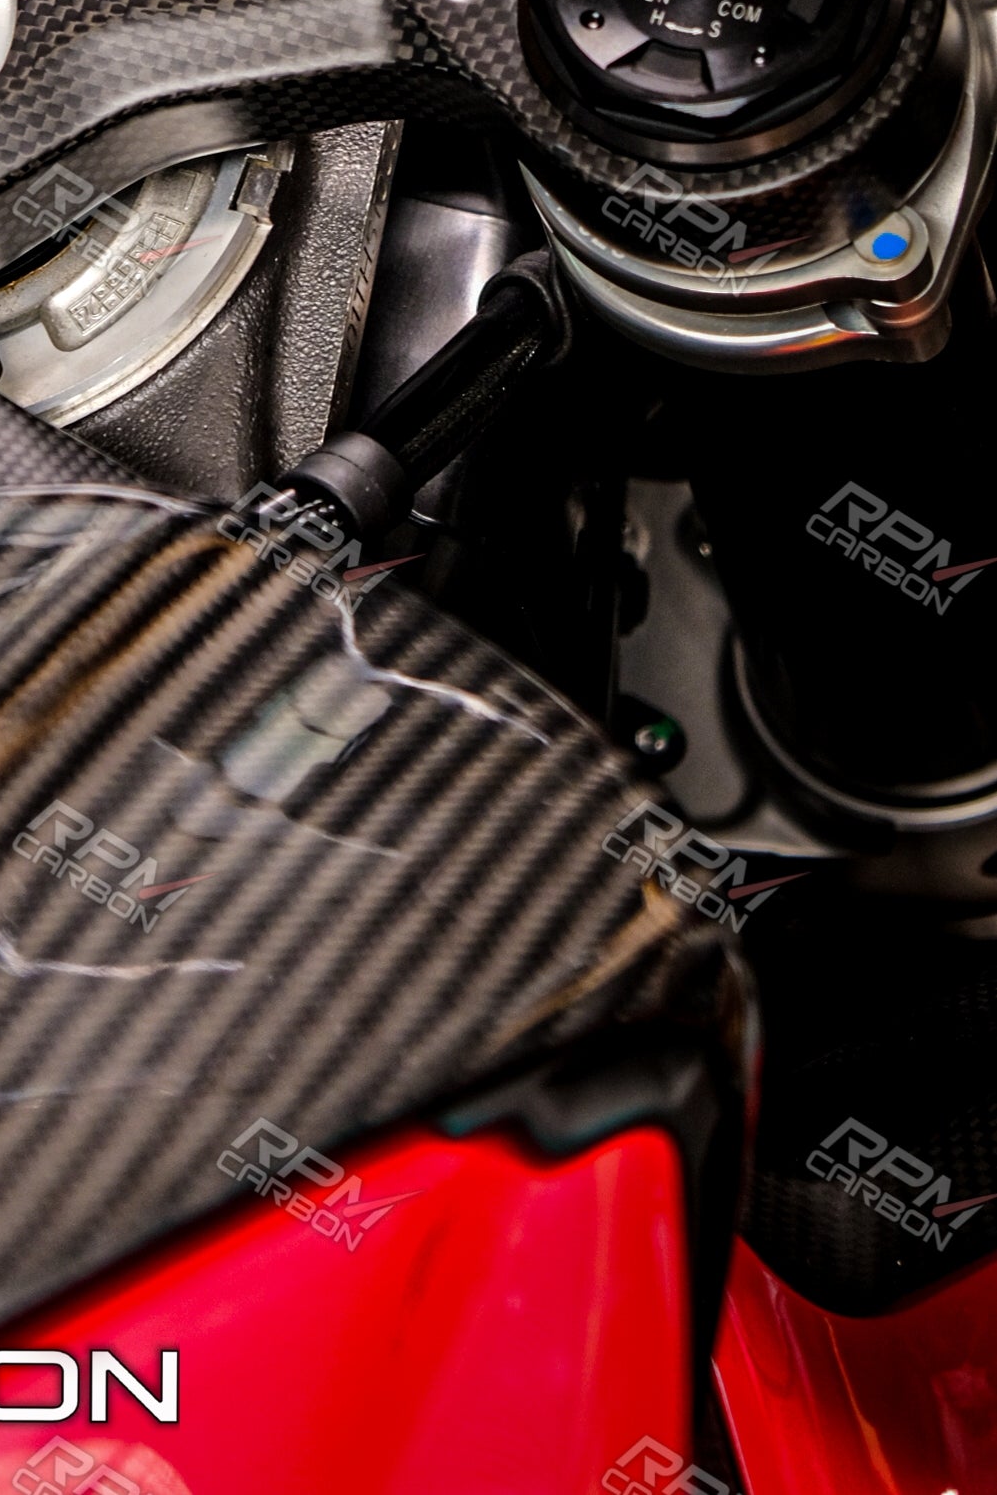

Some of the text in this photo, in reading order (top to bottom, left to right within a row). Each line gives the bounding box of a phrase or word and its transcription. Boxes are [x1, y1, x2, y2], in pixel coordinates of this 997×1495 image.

[649, 9, 722, 39] H S
[717, 0, 762, 24] COM
